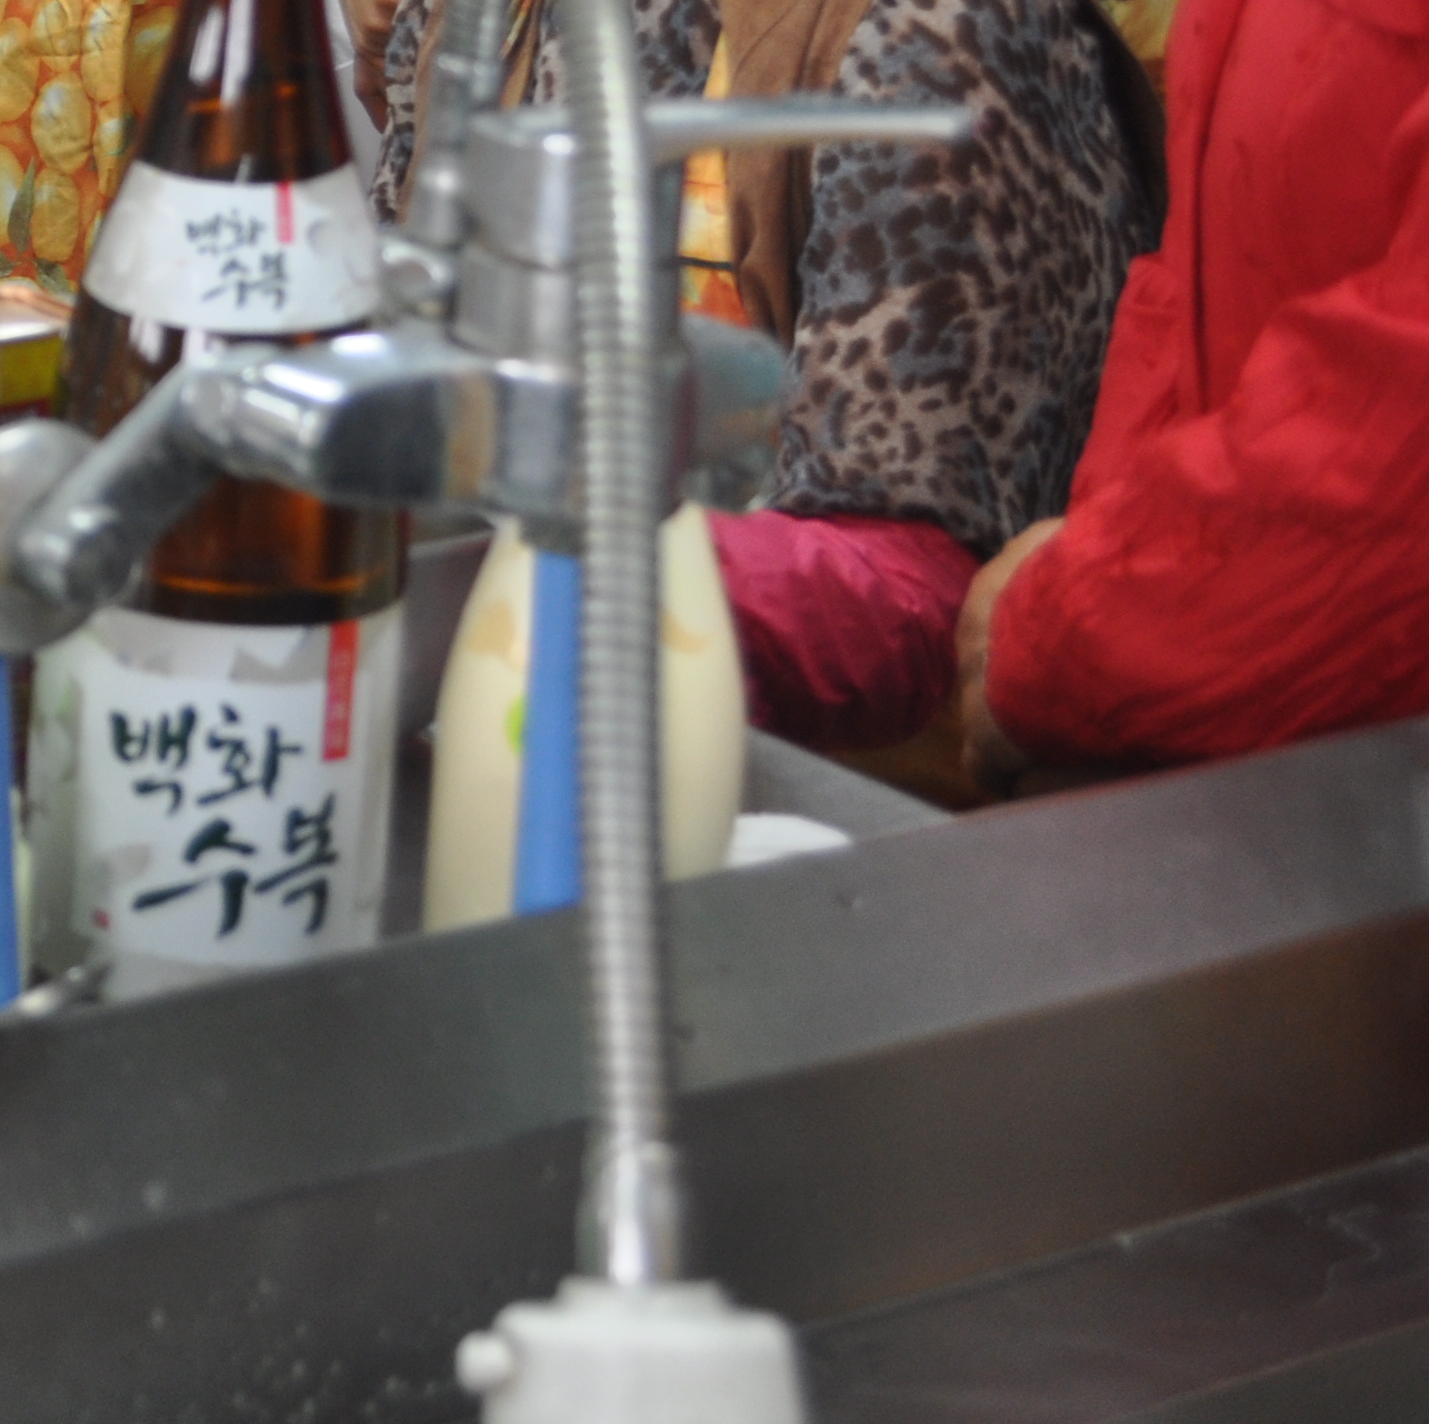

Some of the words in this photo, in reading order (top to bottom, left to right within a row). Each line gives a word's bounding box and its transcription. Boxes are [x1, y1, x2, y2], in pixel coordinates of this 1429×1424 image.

[184, 207, 267, 258] 백화
[199, 249, 288, 312] 수복
[108, 702, 305, 816] 백화
[131, 791, 340, 939] 수복
